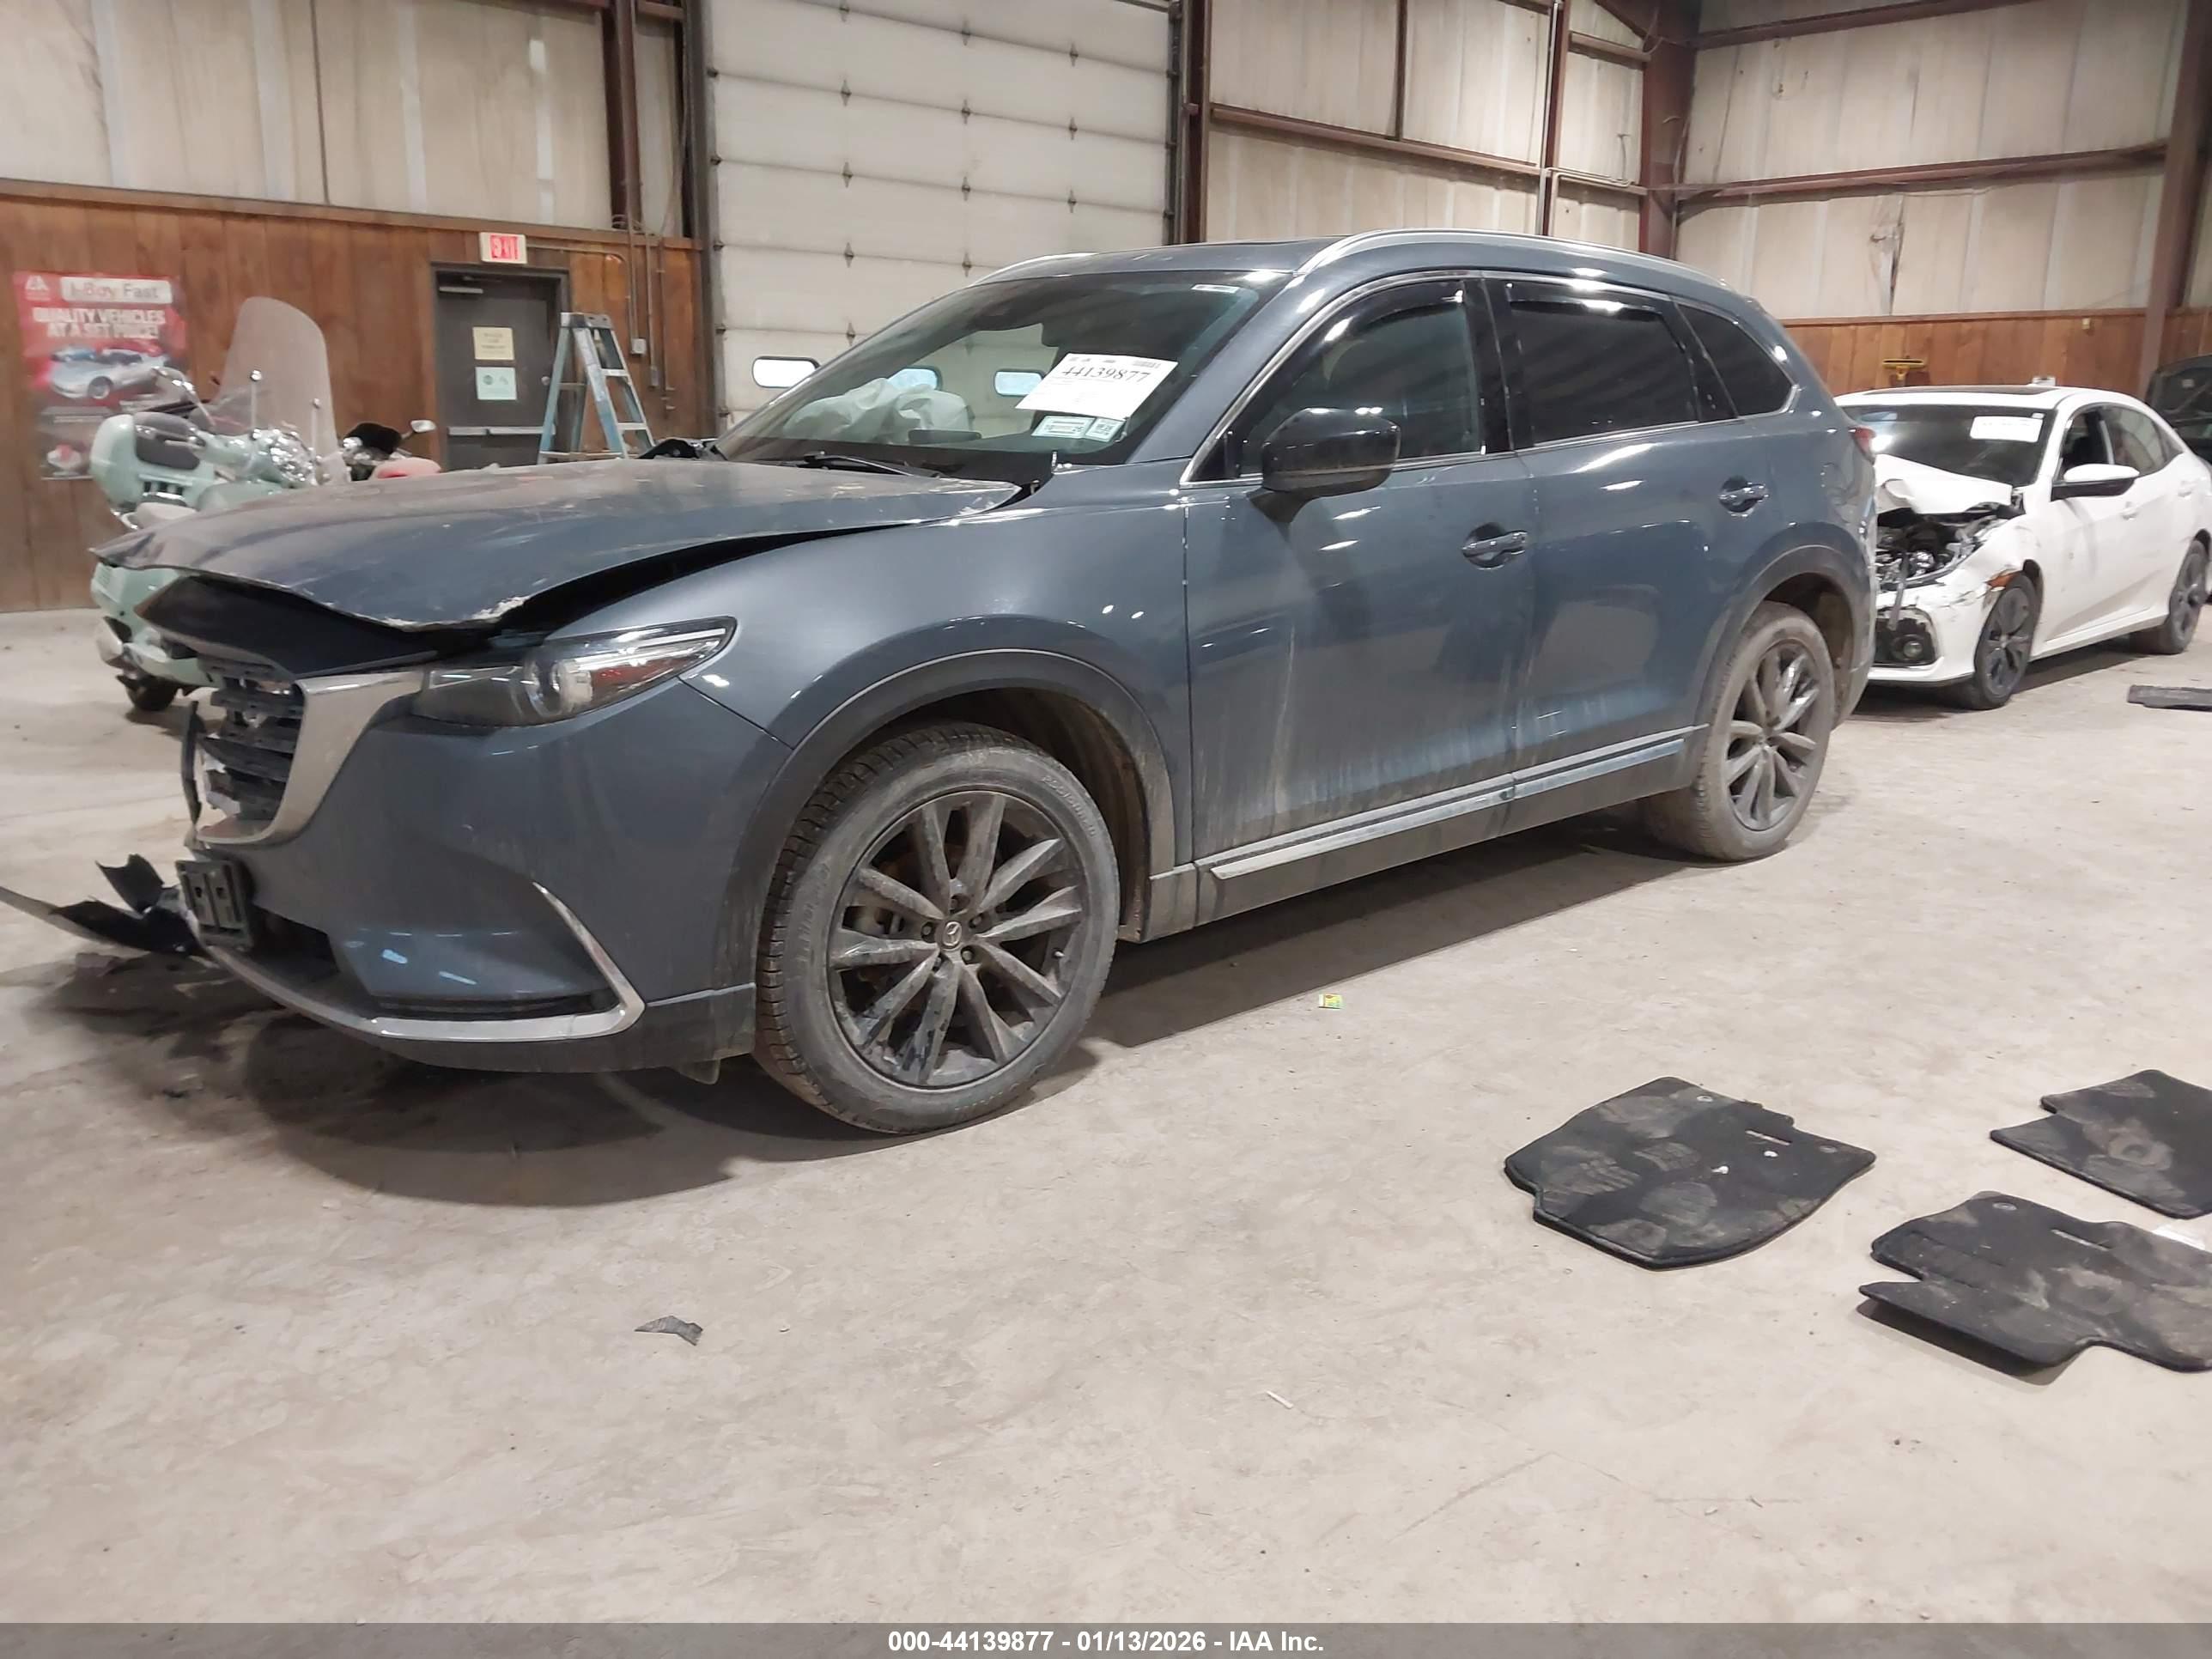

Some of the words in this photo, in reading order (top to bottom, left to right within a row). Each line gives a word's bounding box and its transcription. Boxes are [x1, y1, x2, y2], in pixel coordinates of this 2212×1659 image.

[123, 283, 158, 300] Fast
[33, 307, 96, 323] QUALITY
[96, 308, 166, 325] VEHICLES
[1061, 365, 1152, 382] 44139877
